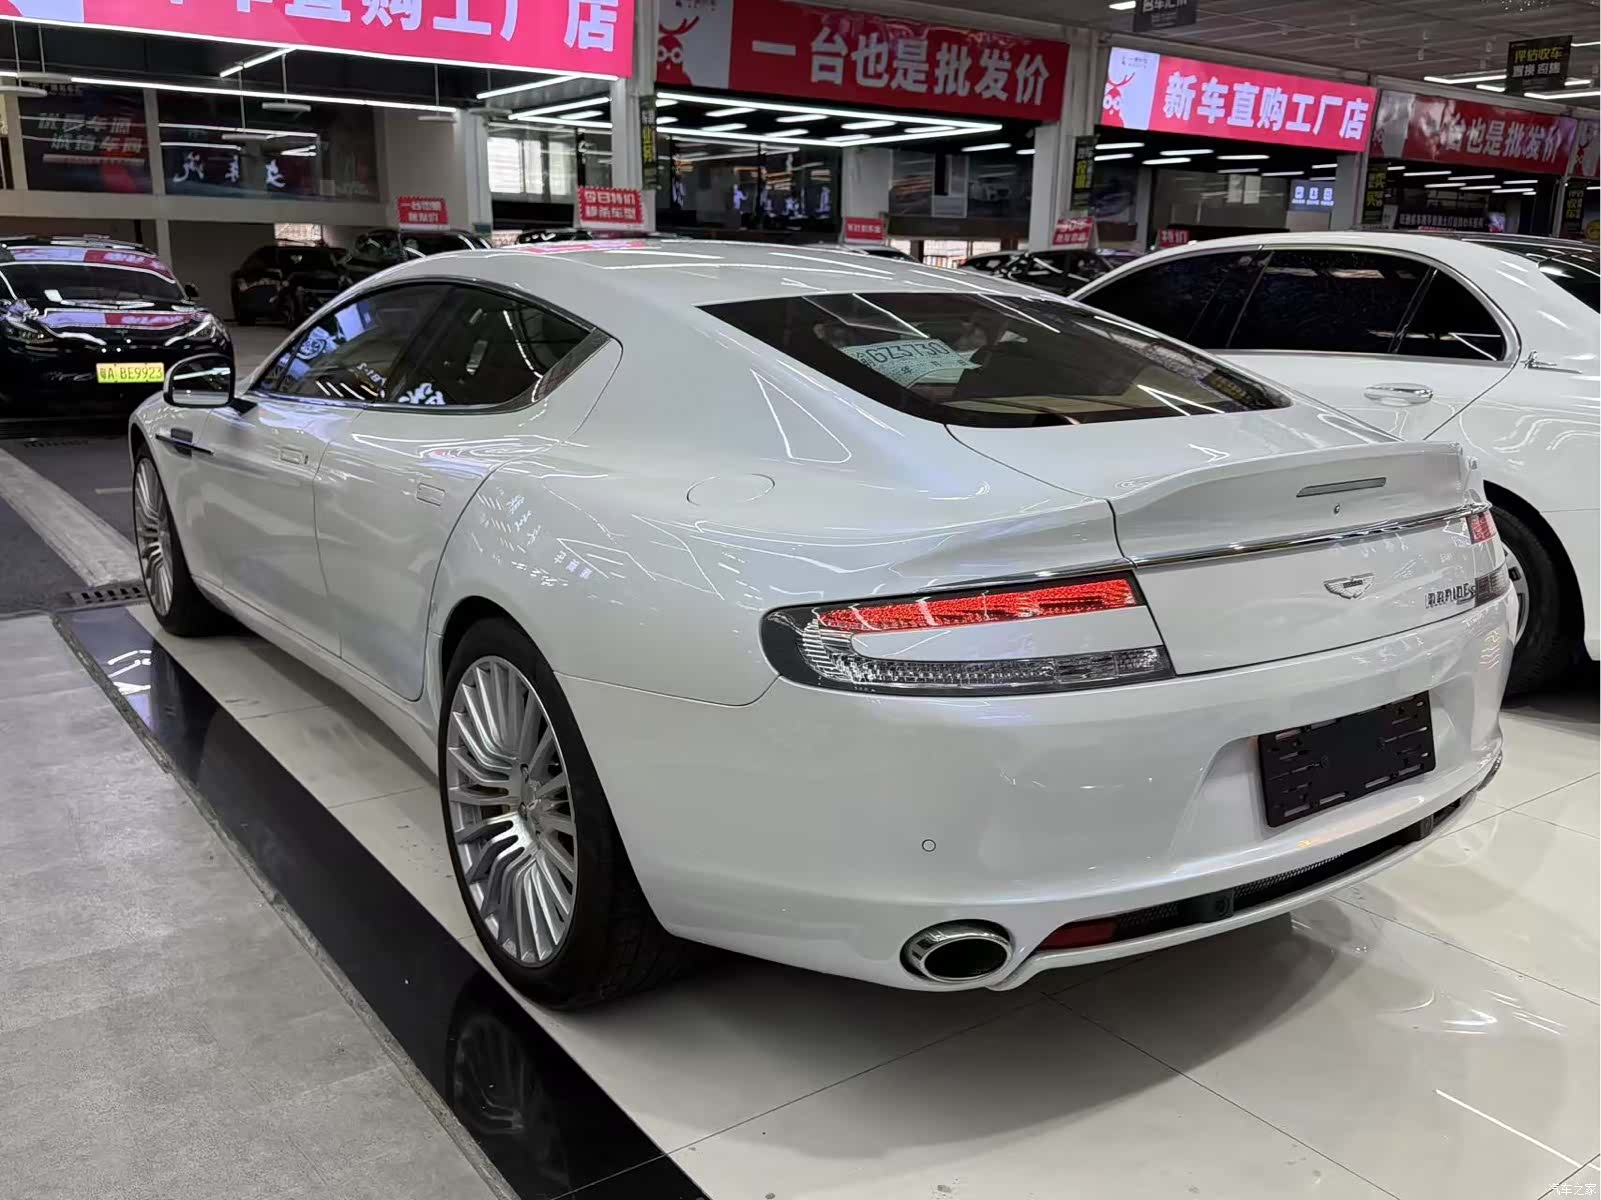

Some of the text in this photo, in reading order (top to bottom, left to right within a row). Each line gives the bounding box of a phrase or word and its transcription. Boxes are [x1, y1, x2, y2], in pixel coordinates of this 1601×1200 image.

[751, 27, 1050, 106] 一台也是批发价
[1163, 71, 1370, 141] 新车直购工厂店
[1440, 111, 1563, 163] 台也是批发价
[120, 367, 163, 380] BE9923
[866, 341, 950, 363] GZ3730
